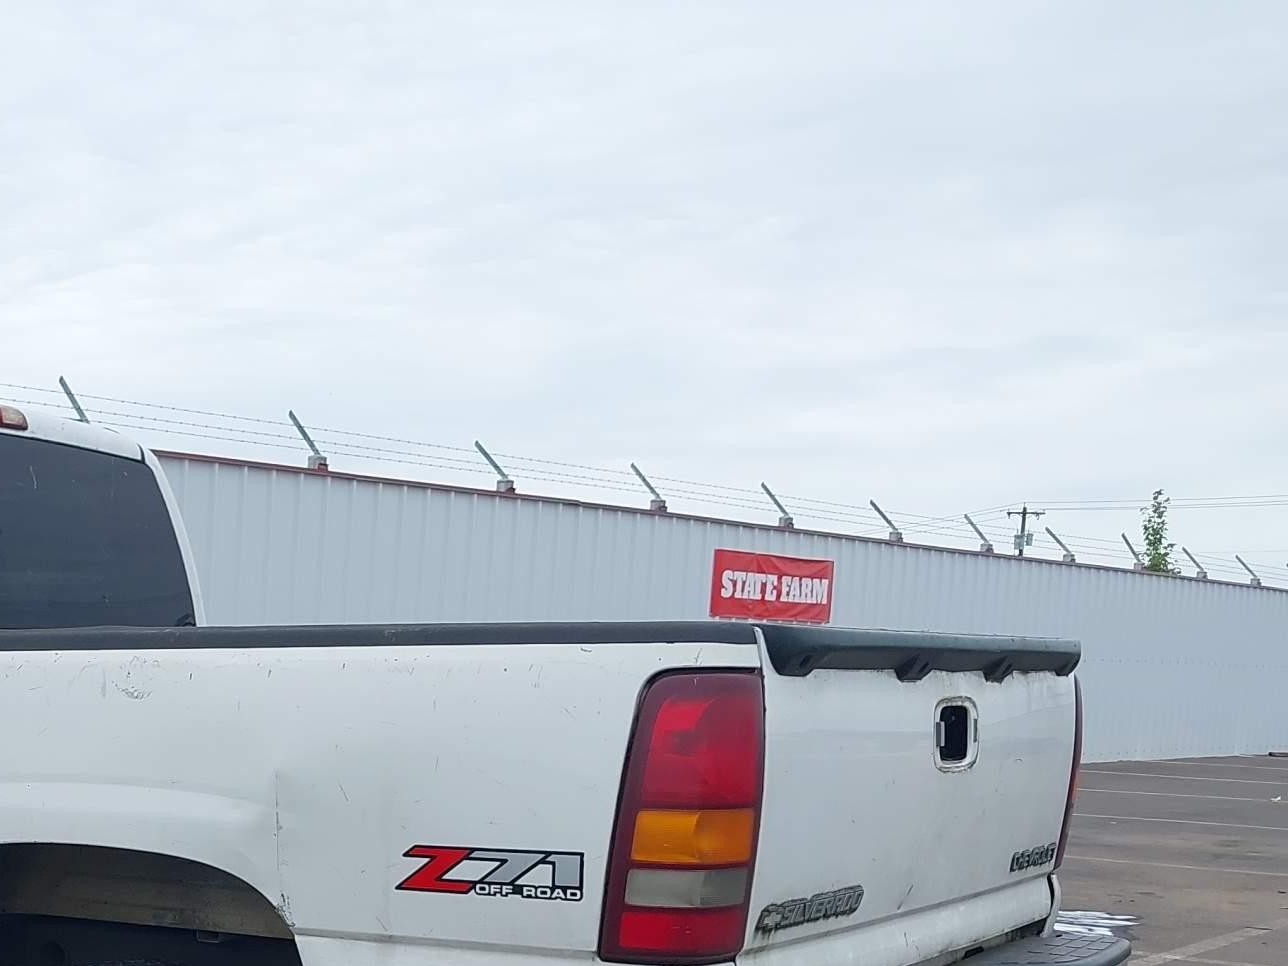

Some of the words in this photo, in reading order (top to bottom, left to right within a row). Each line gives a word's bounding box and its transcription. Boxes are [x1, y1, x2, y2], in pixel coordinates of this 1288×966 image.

[720, 569, 778, 601] STATE
[779, 575, 829, 605] FARM
[394, 844, 585, 895] Z71
[1009, 842, 1056, 872] CHEVROLE
[474, 883, 513, 898] OFF
[522, 886, 582, 901] ROAD
[778, 885, 864, 930] SILVERADO
